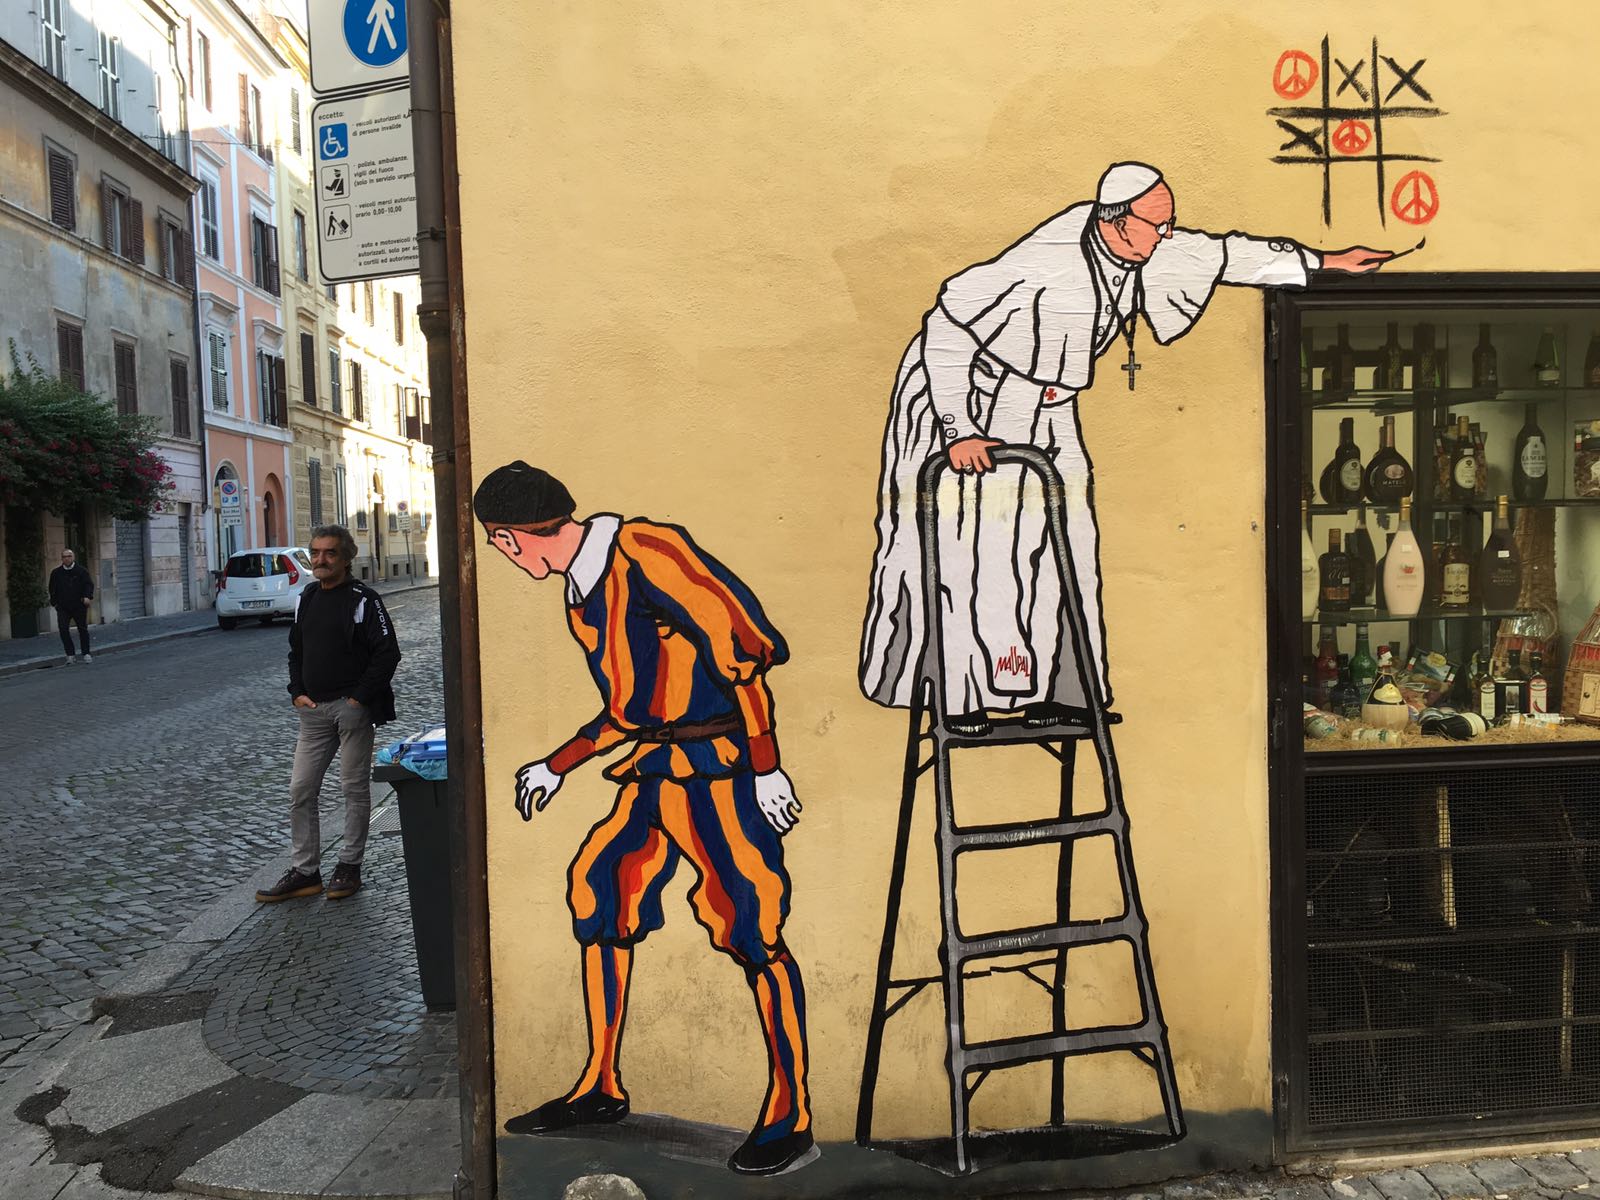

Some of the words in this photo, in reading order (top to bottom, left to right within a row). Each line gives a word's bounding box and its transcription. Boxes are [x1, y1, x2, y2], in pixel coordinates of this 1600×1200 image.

[318, 111, 345, 121] eccetto:
[356, 119, 373, 127] veicoli
[374, 115, 401, 124] autorizzati
[359, 127, 380, 136] persone
[381, 123, 402, 131] invalide
[354, 170, 367, 178] vigili
[354, 179, 368, 187] (solo
[376, 174, 396, 183] servizio
[380, 236, 411, 246] motoveicoli
[363, 258, 379, 266] cortili
